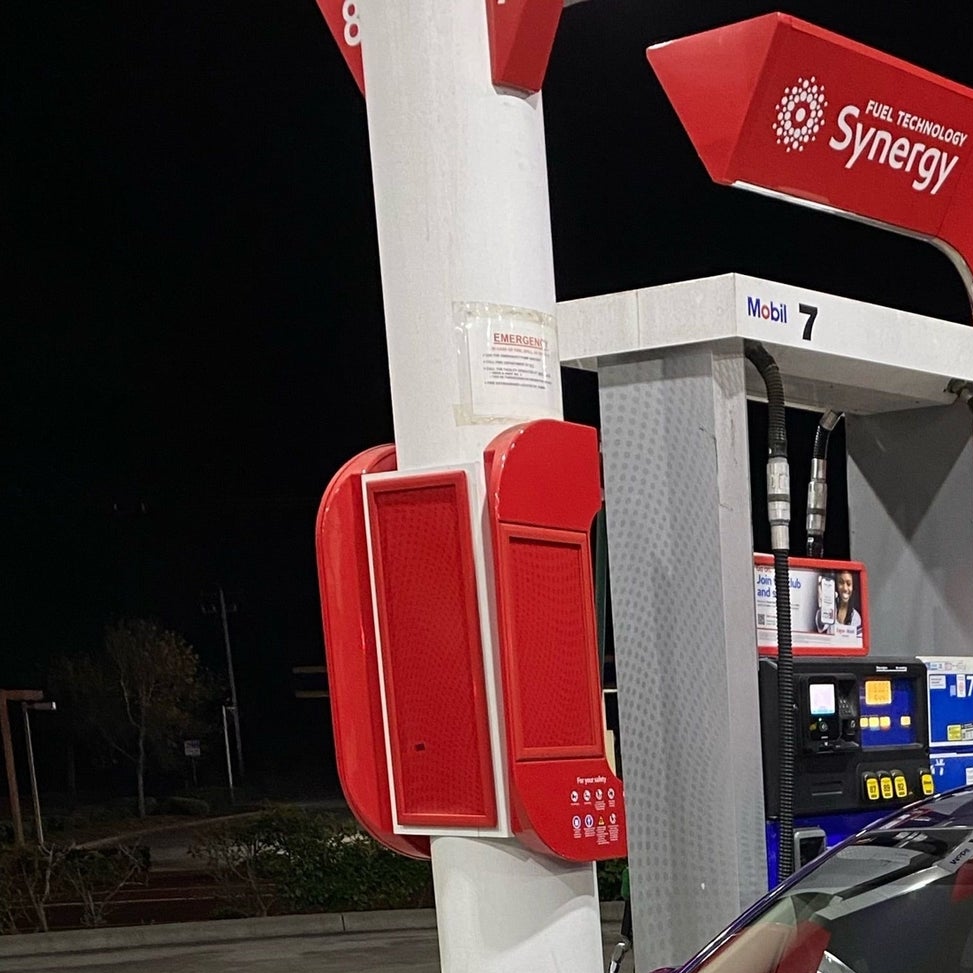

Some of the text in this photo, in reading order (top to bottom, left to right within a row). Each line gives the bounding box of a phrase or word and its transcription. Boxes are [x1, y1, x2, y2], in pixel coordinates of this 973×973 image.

[341, 0, 362, 47] 8
[865, 99, 969, 147] FUEL TECHNOLOGY
[828, 104, 960, 195] Synergy
[747, 296, 788, 324] Mobil
[798, 303, 819, 341] 7
[756, 574, 802, 589] Join lub
[757, 588, 771, 598] and
